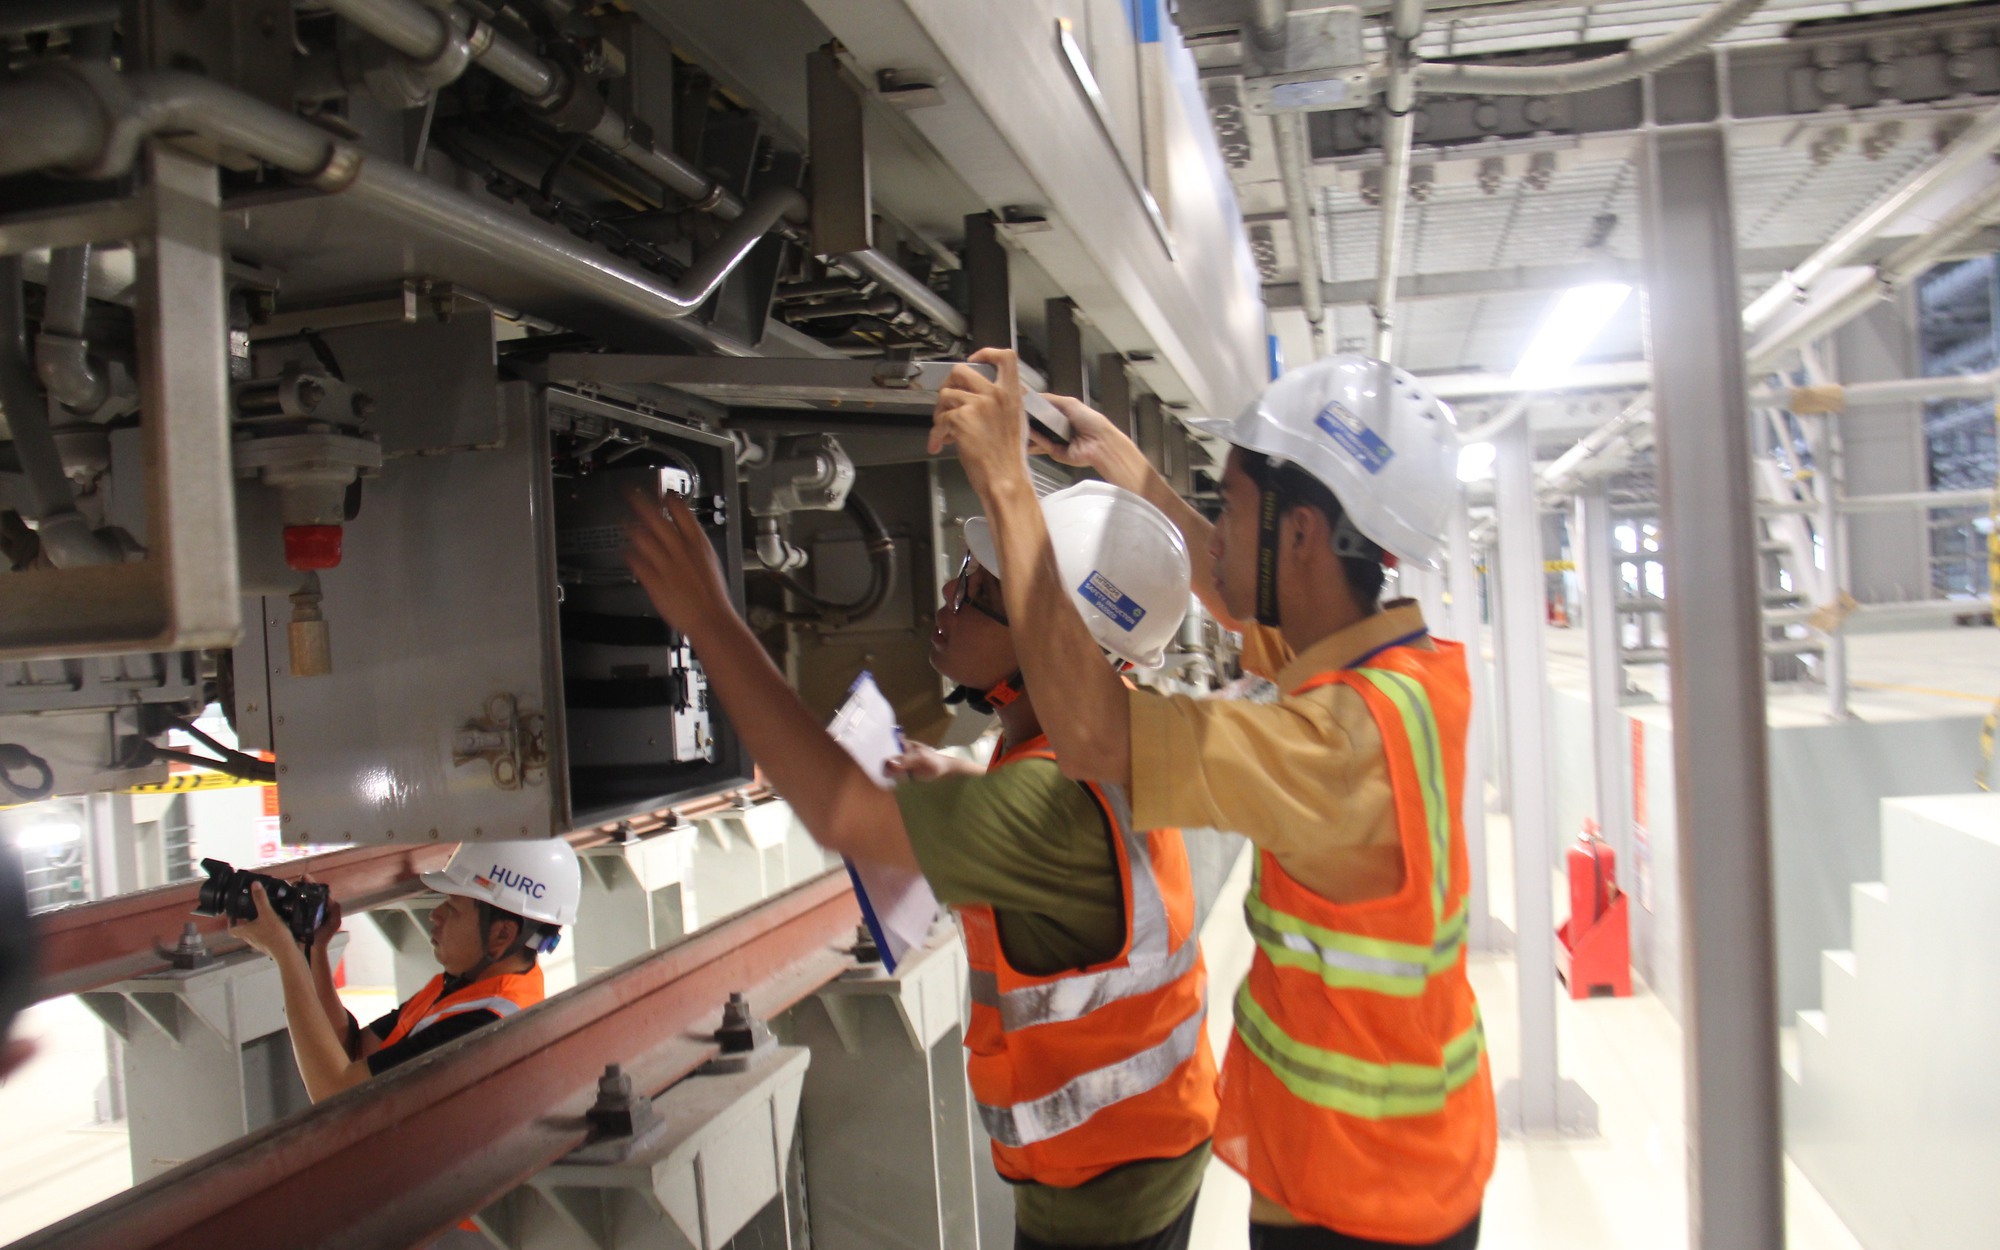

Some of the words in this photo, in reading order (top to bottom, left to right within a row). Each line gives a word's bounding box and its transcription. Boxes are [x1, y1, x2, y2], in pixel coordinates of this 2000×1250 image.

[1085, 583, 1107, 602] SAFETY
[1106, 599, 1136, 625] INDUCTION
[1095, 601, 1118, 620] PASSED
[489, 864, 546, 899] HURC
